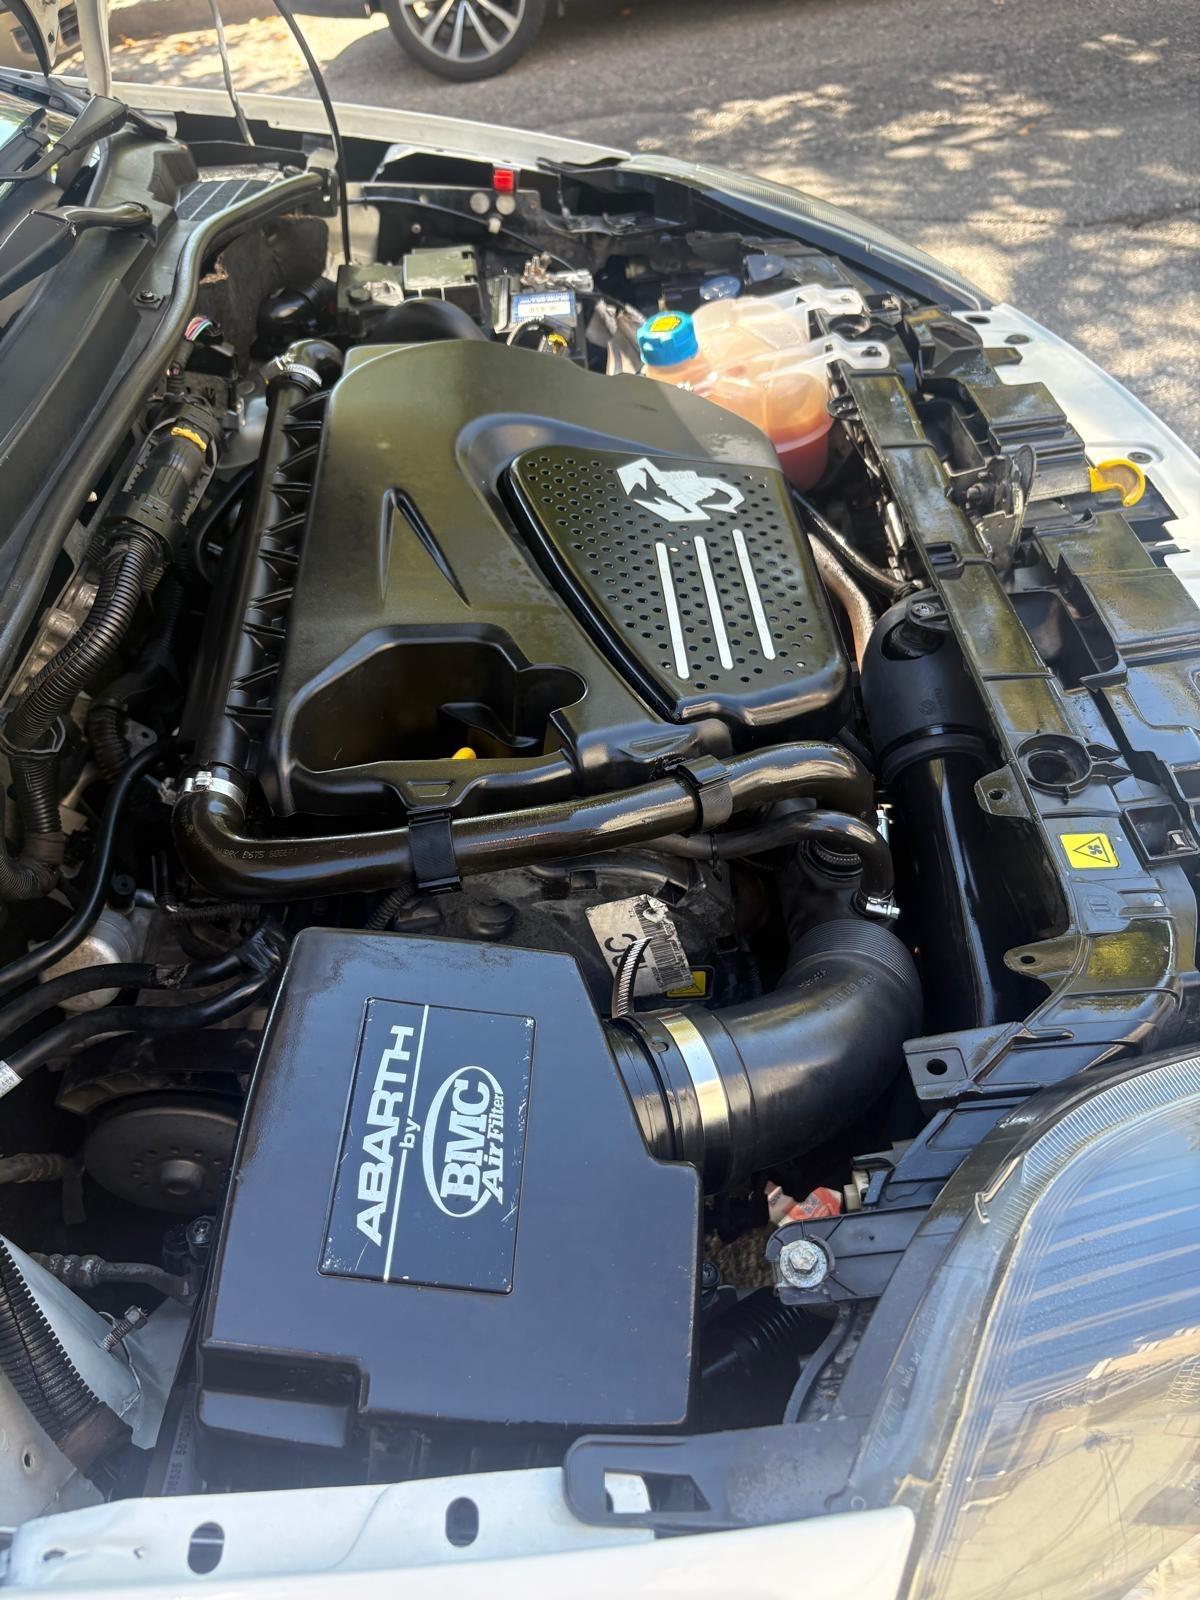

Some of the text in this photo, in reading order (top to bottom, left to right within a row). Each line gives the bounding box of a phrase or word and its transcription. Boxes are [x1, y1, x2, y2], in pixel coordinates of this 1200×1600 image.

[356, 1024, 414, 1247] ABARTH
[399, 1114, 421, 1150] by
[440, 1078, 491, 1203] BMC
[481, 1091, 504, 1205] Air Filter
